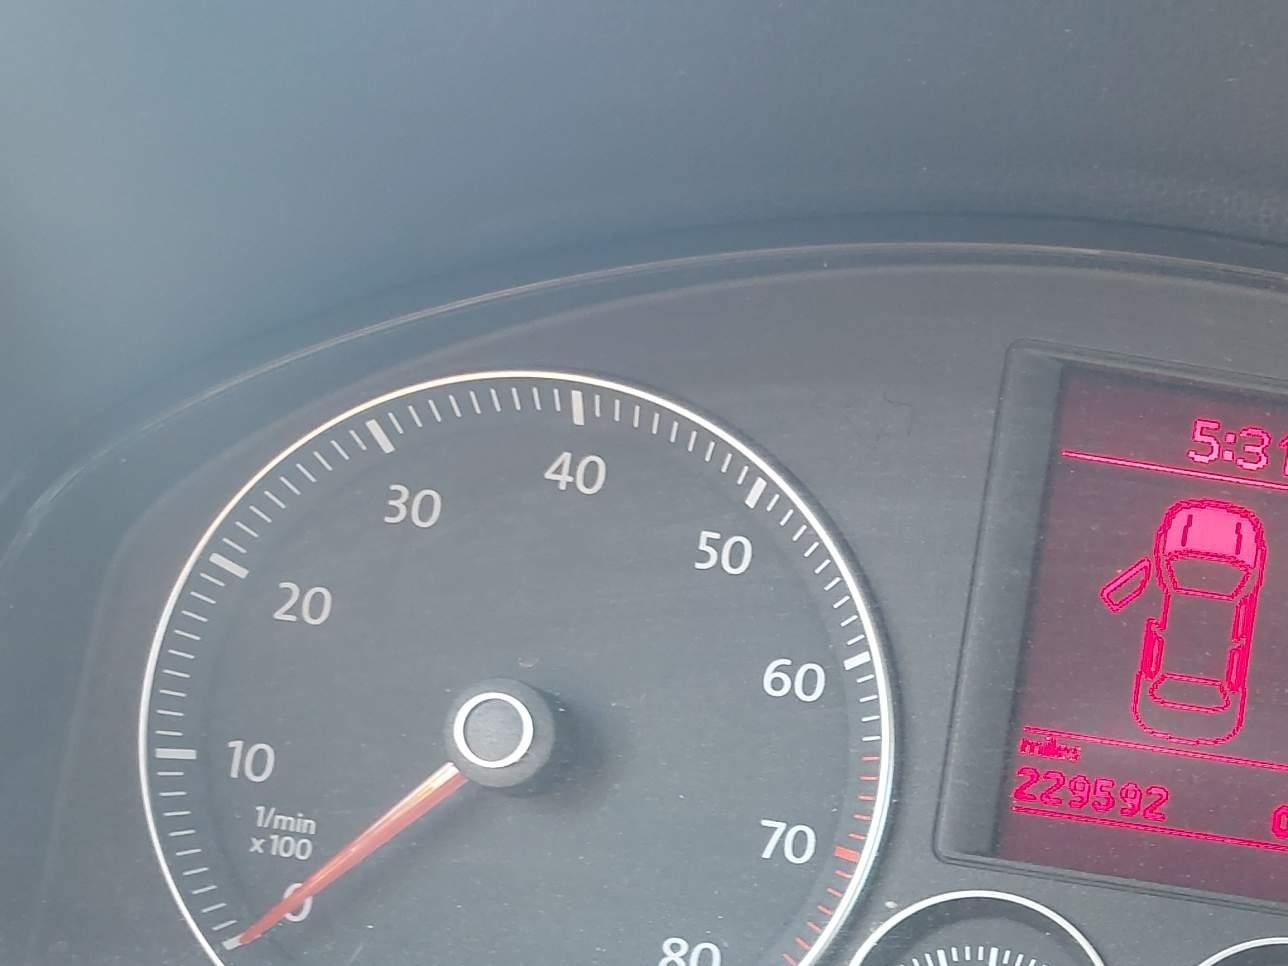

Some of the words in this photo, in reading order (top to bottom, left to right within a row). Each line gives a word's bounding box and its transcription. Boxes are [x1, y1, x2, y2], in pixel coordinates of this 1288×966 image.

[544, 452, 607, 495] 40
[384, 483, 442, 529] 30
[694, 531, 753, 577] 50
[274, 582, 332, 626] 20
[762, 658, 826, 703] 60
[226, 740, 275, 783] 10
[1020, 736, 1081, 761] miles
[1012, 767, 1169, 822] 229592
[254, 805, 316, 835] 1/min
[759, 819, 816, 864] 70
[268, 833, 313, 861] 100
